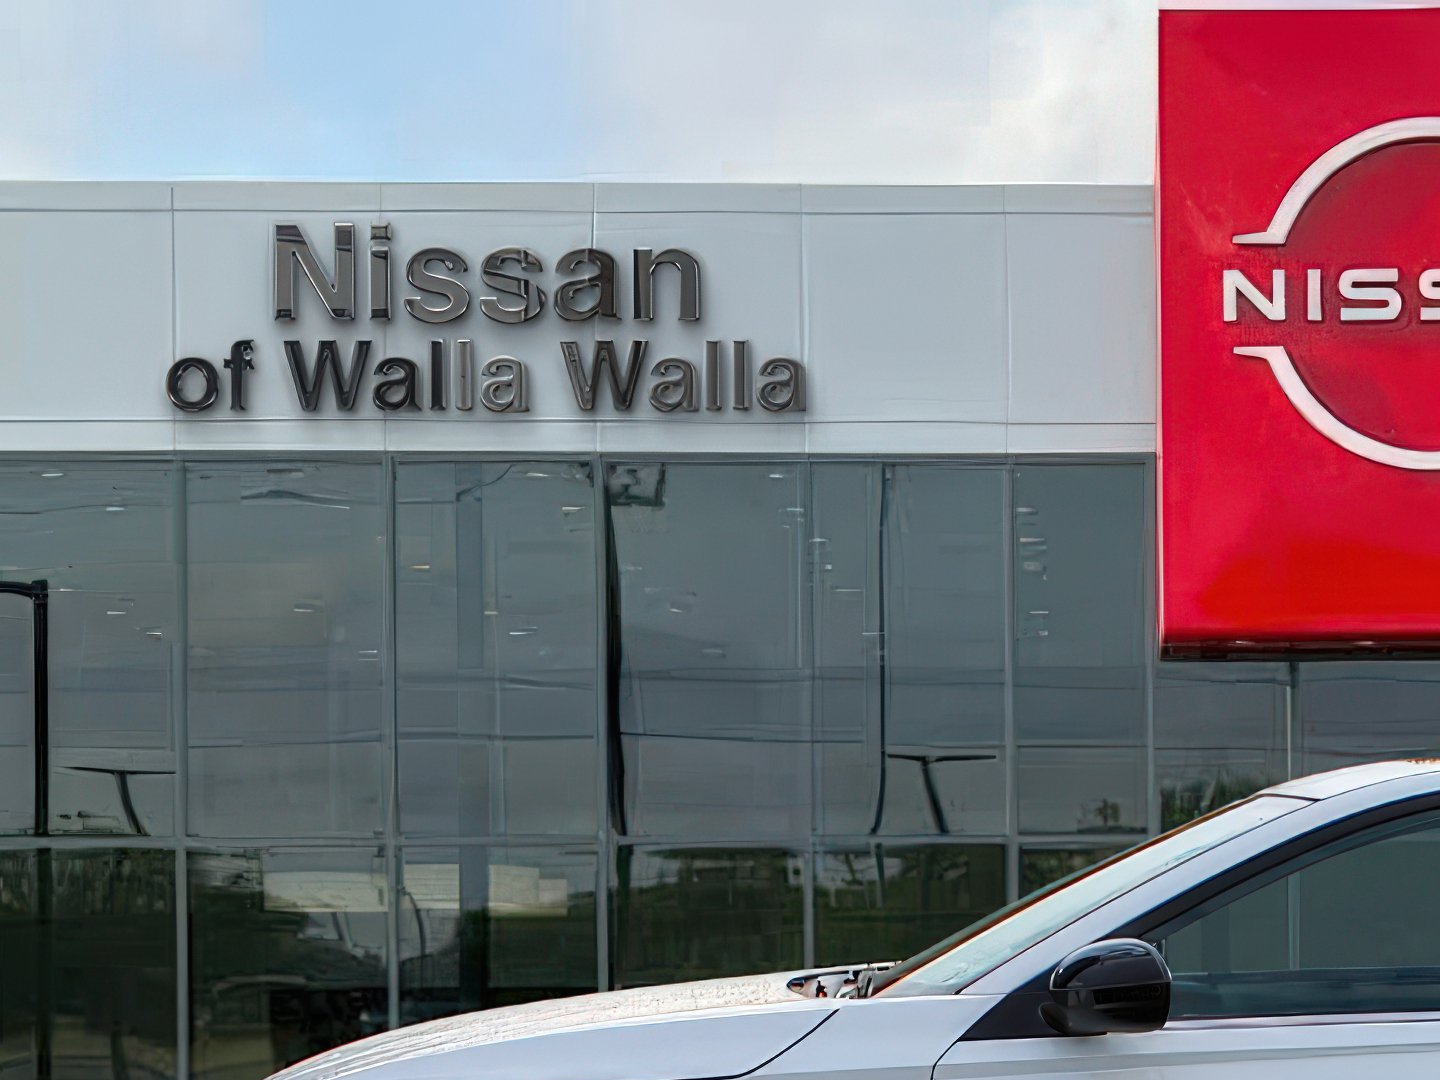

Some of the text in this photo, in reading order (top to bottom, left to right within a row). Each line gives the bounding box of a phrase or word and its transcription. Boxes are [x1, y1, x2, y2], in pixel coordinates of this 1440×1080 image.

[274, 221, 701, 324] Nissan
[165, 338, 807, 412] of Walla Walla
